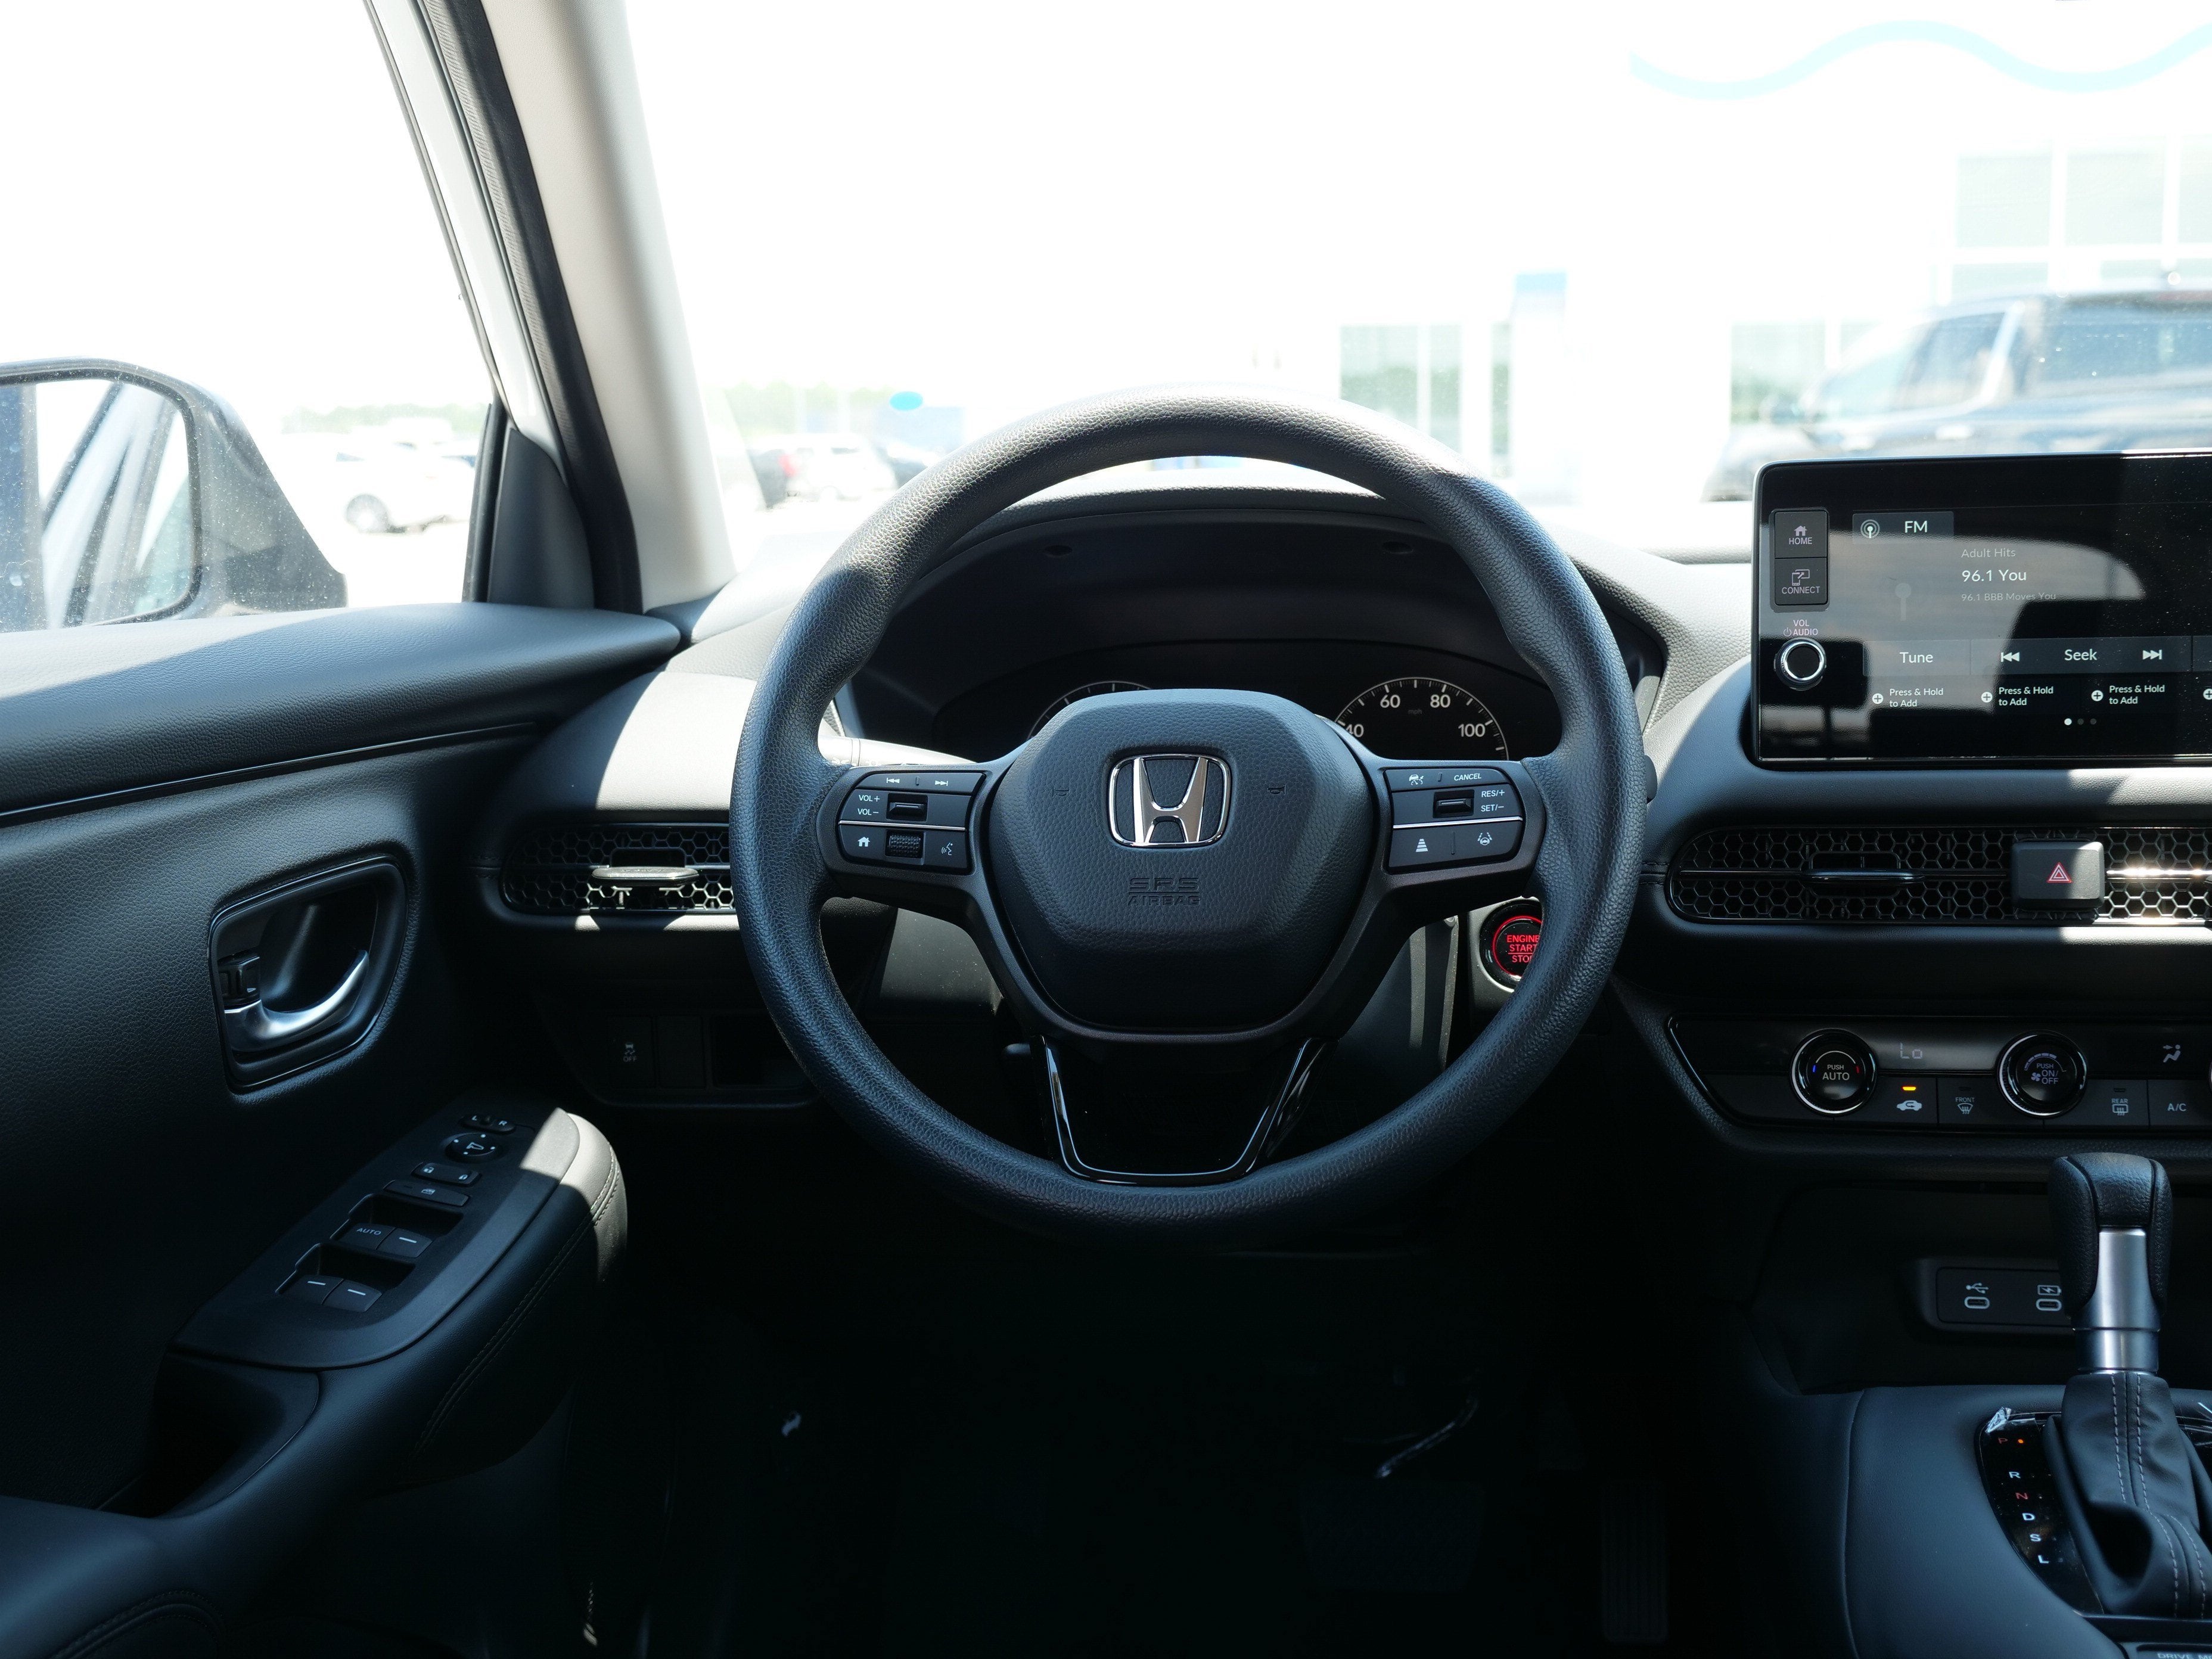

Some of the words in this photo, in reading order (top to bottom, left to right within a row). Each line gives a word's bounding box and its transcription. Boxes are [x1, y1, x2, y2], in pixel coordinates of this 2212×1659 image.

[1905, 520, 1928, 533] FM
[1961, 548, 1991, 558] Adult
[1994, 548, 2016, 557] Hits
[1962, 570, 1993, 582] 96.1
[1999, 569, 2027, 582] You
[2006, 593, 2036, 601] Moves
[2039, 592, 2056, 600] You
[1900, 651, 1934, 663] Tune
[2064, 648, 2098, 661] Seek
[1890, 688, 1912, 697] Press
[1914, 688, 1921, 696] &
[1924, 687, 1944, 696] Hold
[1999, 686, 2021, 695] Press
[2024, 686, 2031, 695] &
[2033, 685, 2054, 695] Hold
[2109, 685, 2132, 694] Press
[2135, 685, 2142, 694] &
[2144, 684, 2166, 693] Hold
[1380, 694, 1400, 708] 60
[1430, 694, 1450, 708] 80
[1900, 698, 1918, 707] Add
[2009, 697, 2027, 706] Add
[2120, 696, 2138, 704] Add
[1458, 723, 1486, 738] 100
[1129, 878, 1200, 891] SRS
[1127, 896, 1201, 906] AIRBAG
[1509, 944, 1537, 952] START
[1822, 1073, 1850, 1081] AUTO
[2023, 1512, 2036, 1521] D
[2030, 1533, 2042, 1542] S
[2038, 1555, 2050, 1564] L
